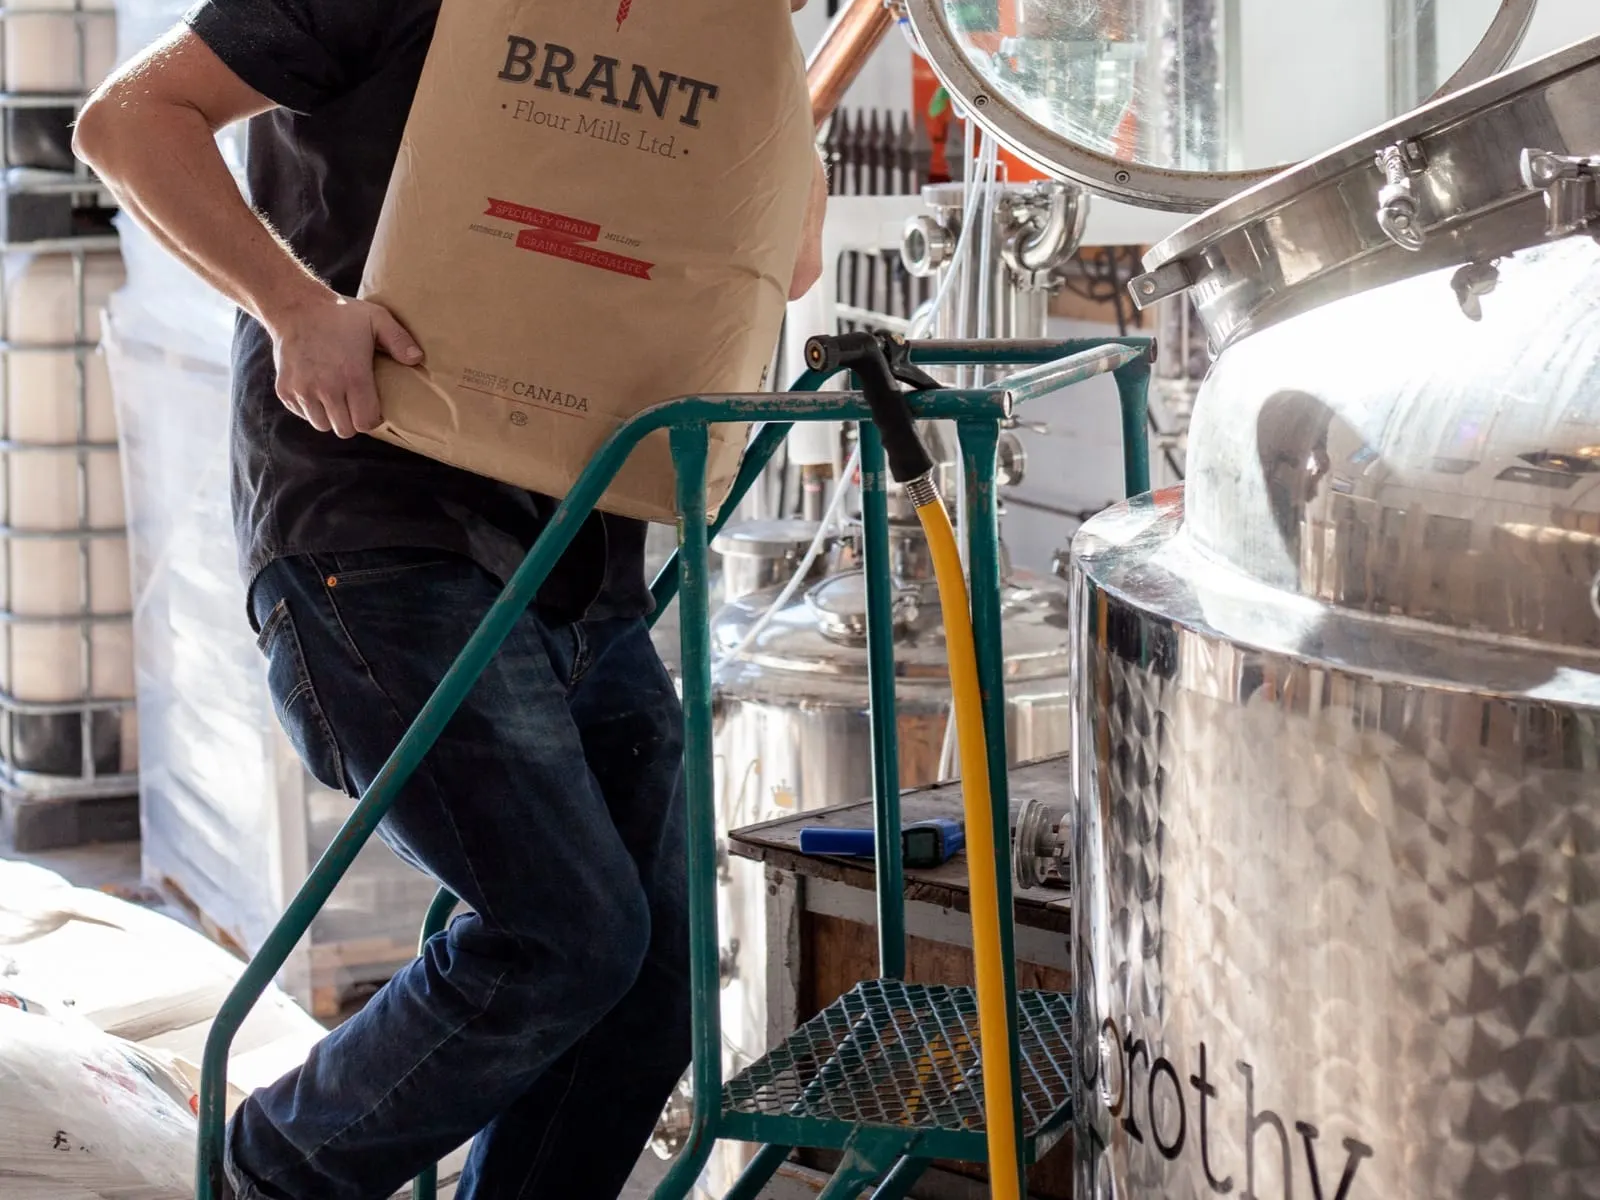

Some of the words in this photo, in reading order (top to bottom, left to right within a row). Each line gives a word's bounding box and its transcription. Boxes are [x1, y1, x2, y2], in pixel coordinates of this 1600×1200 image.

[497, 34, 720, 130] BRANT
[512, 99, 570, 132] Flour
[573, 114, 631, 147] Mills
[636, 129, 678, 160] Ltd.
[555, 218, 593, 237] GRAIN
[522, 235, 558, 253] GRAIN
[512, 381, 588, 412] CANADA
